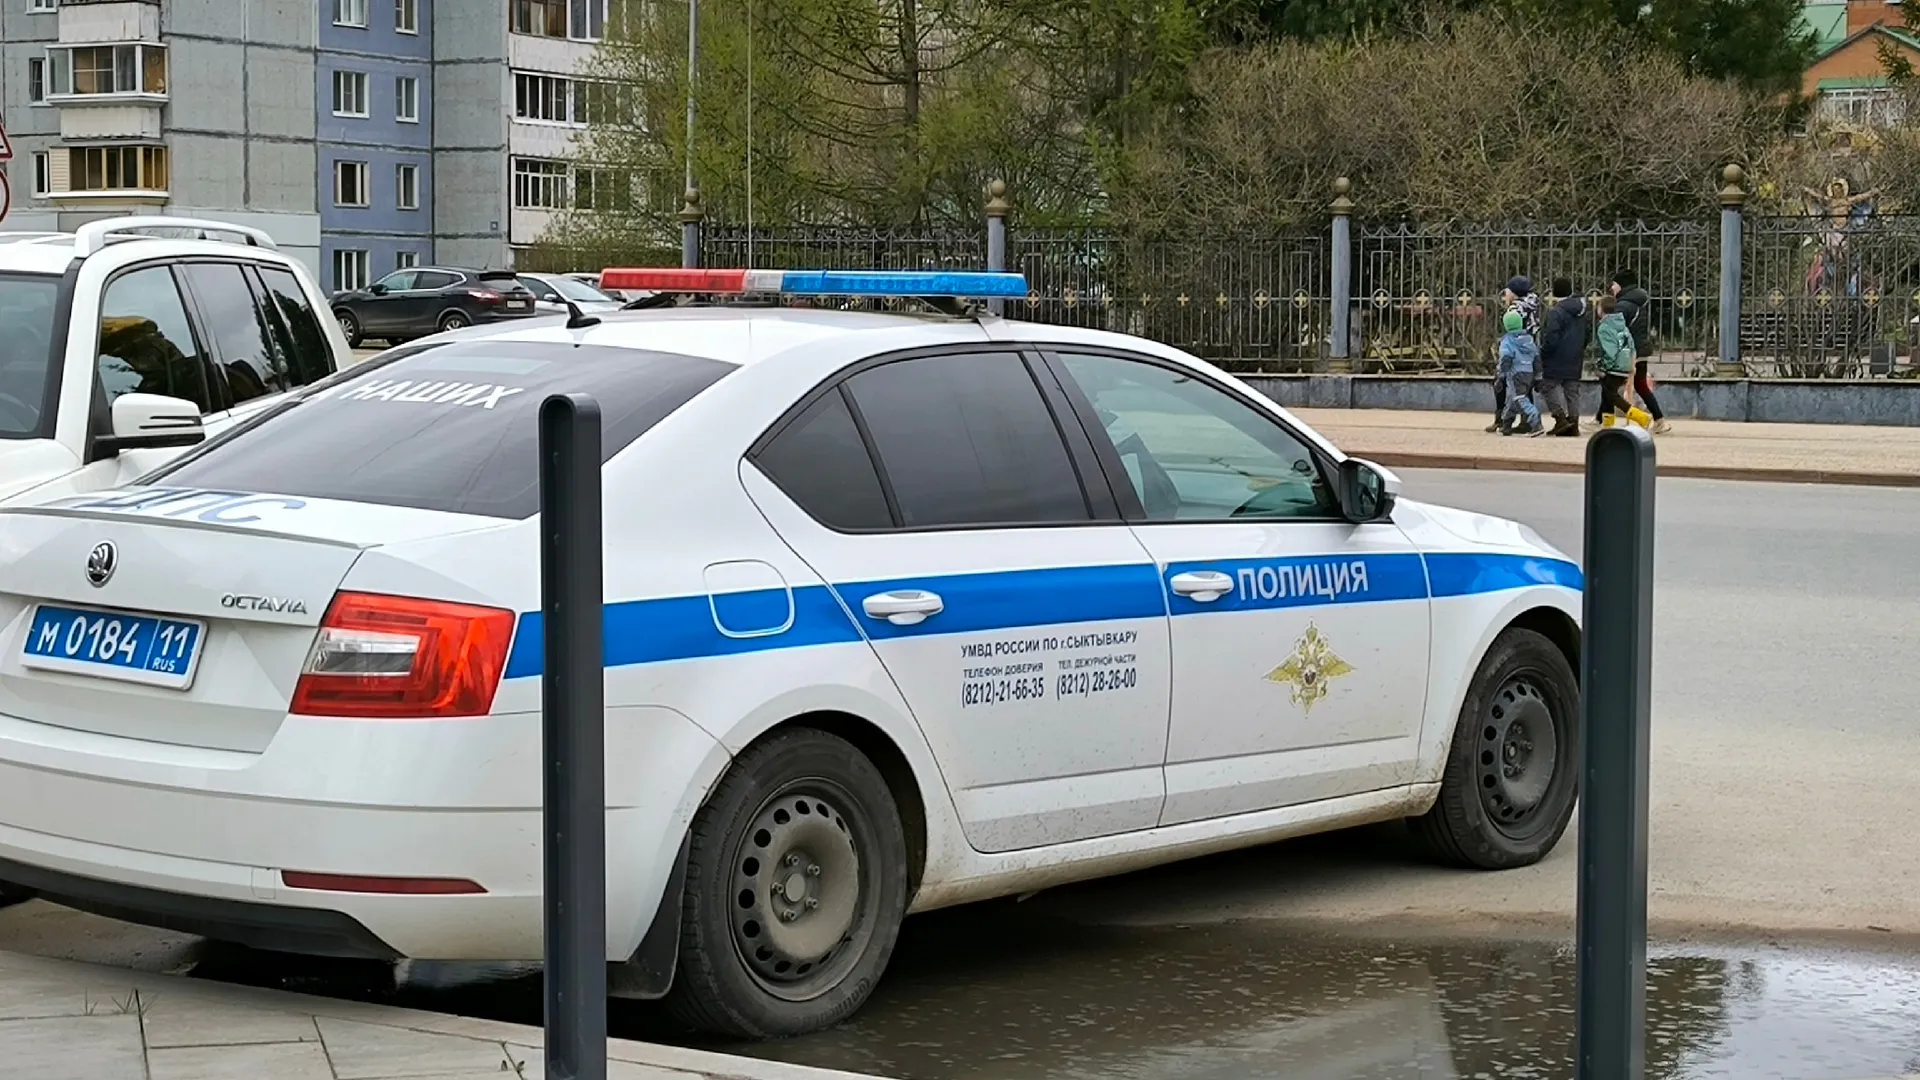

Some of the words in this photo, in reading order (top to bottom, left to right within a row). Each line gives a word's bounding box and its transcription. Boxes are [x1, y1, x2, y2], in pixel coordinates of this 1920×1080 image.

[339, 378, 525, 410] НАШИХ
[1237, 561, 1369, 601] ПОЛИЦИЯ
[220, 593, 308, 615] OCTAVIA
[36, 620, 60, 654] М
[66, 615, 140, 664] 0184
[159, 624, 189, 659] 11
[960, 641, 993, 658] УМВД
[994, 639, 1040, 656] РОССИИ
[1042, 637, 1059, 650] ПО
[152, 657, 176, 672] RUS
[963, 667, 1003, 679] ТЕЛЕФОН
[1004, 662, 1044, 676] ДОВЕРИЯ
[1114, 653, 1137, 664] ЧАСТИ
[961, 676, 1045, 709] (8212)-21-66-35
[1056, 671, 1090, 701] (8212)
[1091, 667, 1137, 692] 28-26-00
